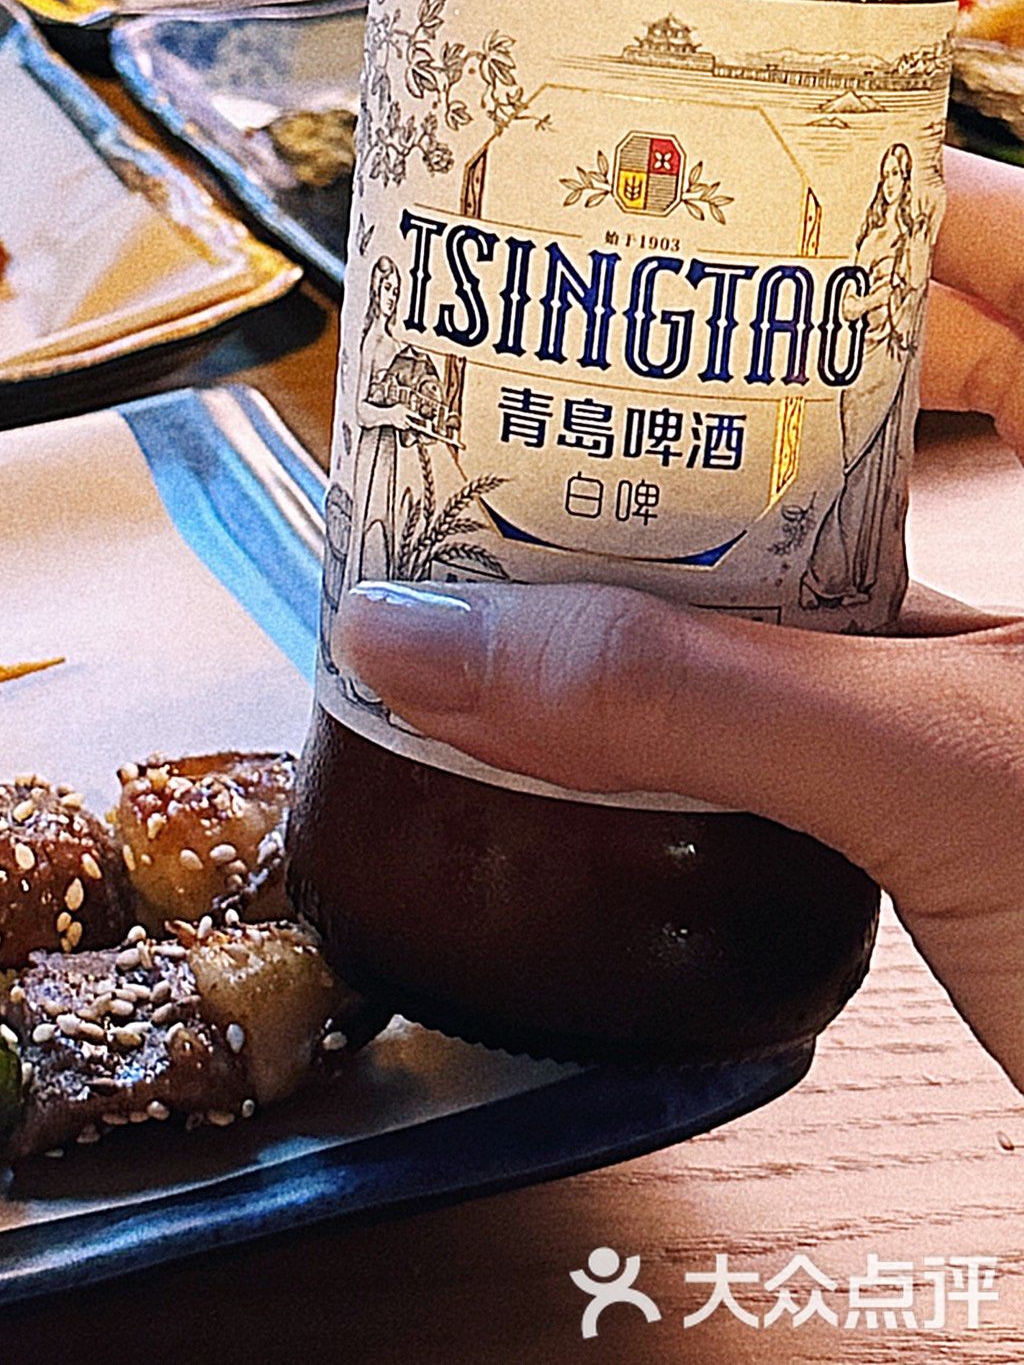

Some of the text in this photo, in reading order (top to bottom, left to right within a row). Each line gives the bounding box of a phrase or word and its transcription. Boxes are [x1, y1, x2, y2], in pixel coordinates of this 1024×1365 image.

[498, 386, 748, 471] 青島啤酒
[565, 471, 660, 526] 白啤
